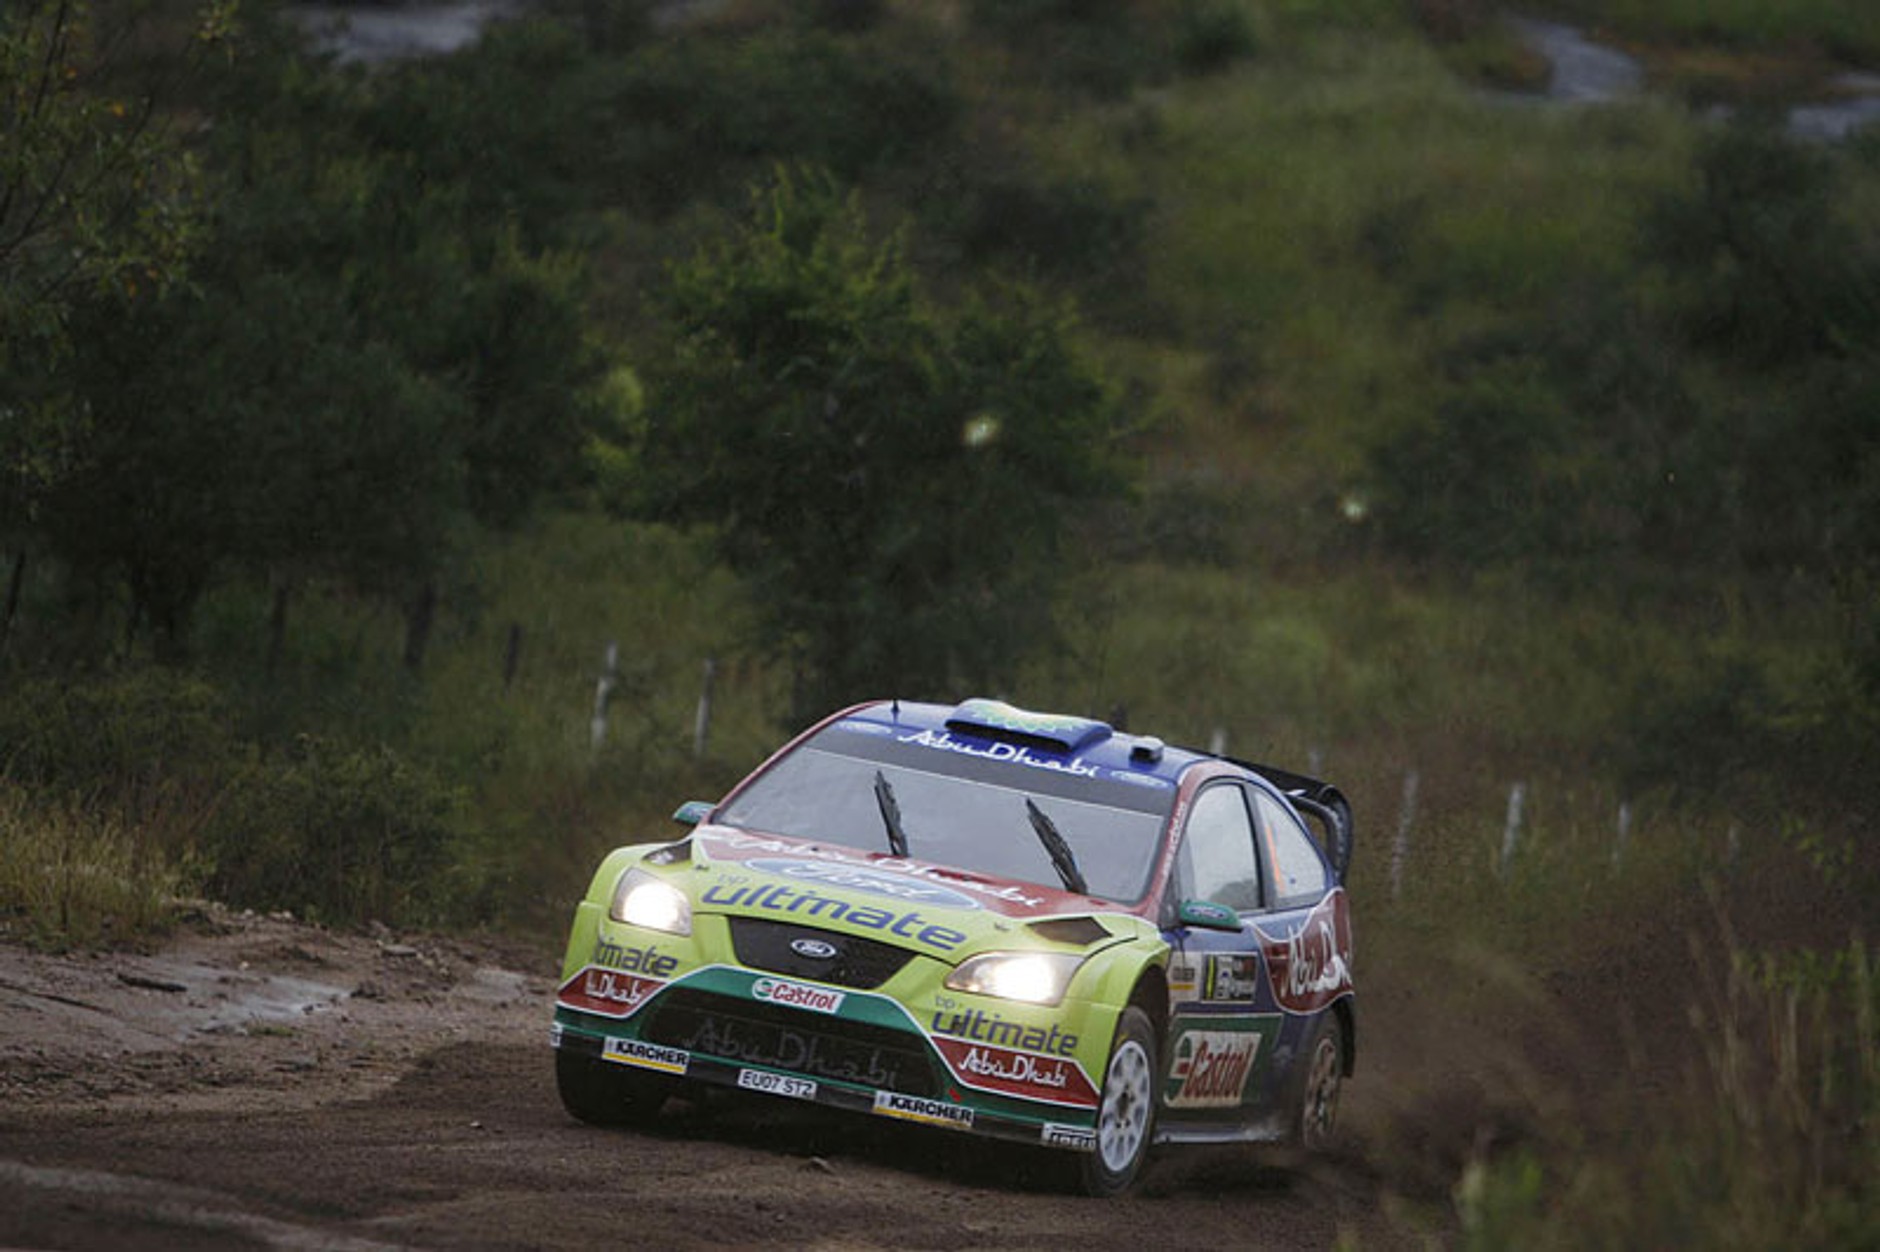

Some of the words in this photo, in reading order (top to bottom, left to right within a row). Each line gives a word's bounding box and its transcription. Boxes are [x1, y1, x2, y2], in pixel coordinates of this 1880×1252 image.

[897, 729, 973, 758] Abu
[974, 741, 1100, 778] Dhabi
[702, 883, 967, 951] ultimate
[770, 983, 838, 1011] Castrol
[931, 1008, 1079, 1057] ultimate
[741, 1071, 779, 1091] EU07
[958, 1047, 1005, 1080] Abu
[1007, 1054, 1068, 1088] Dhabi
[1183, 1040, 1254, 1099] Castrol
